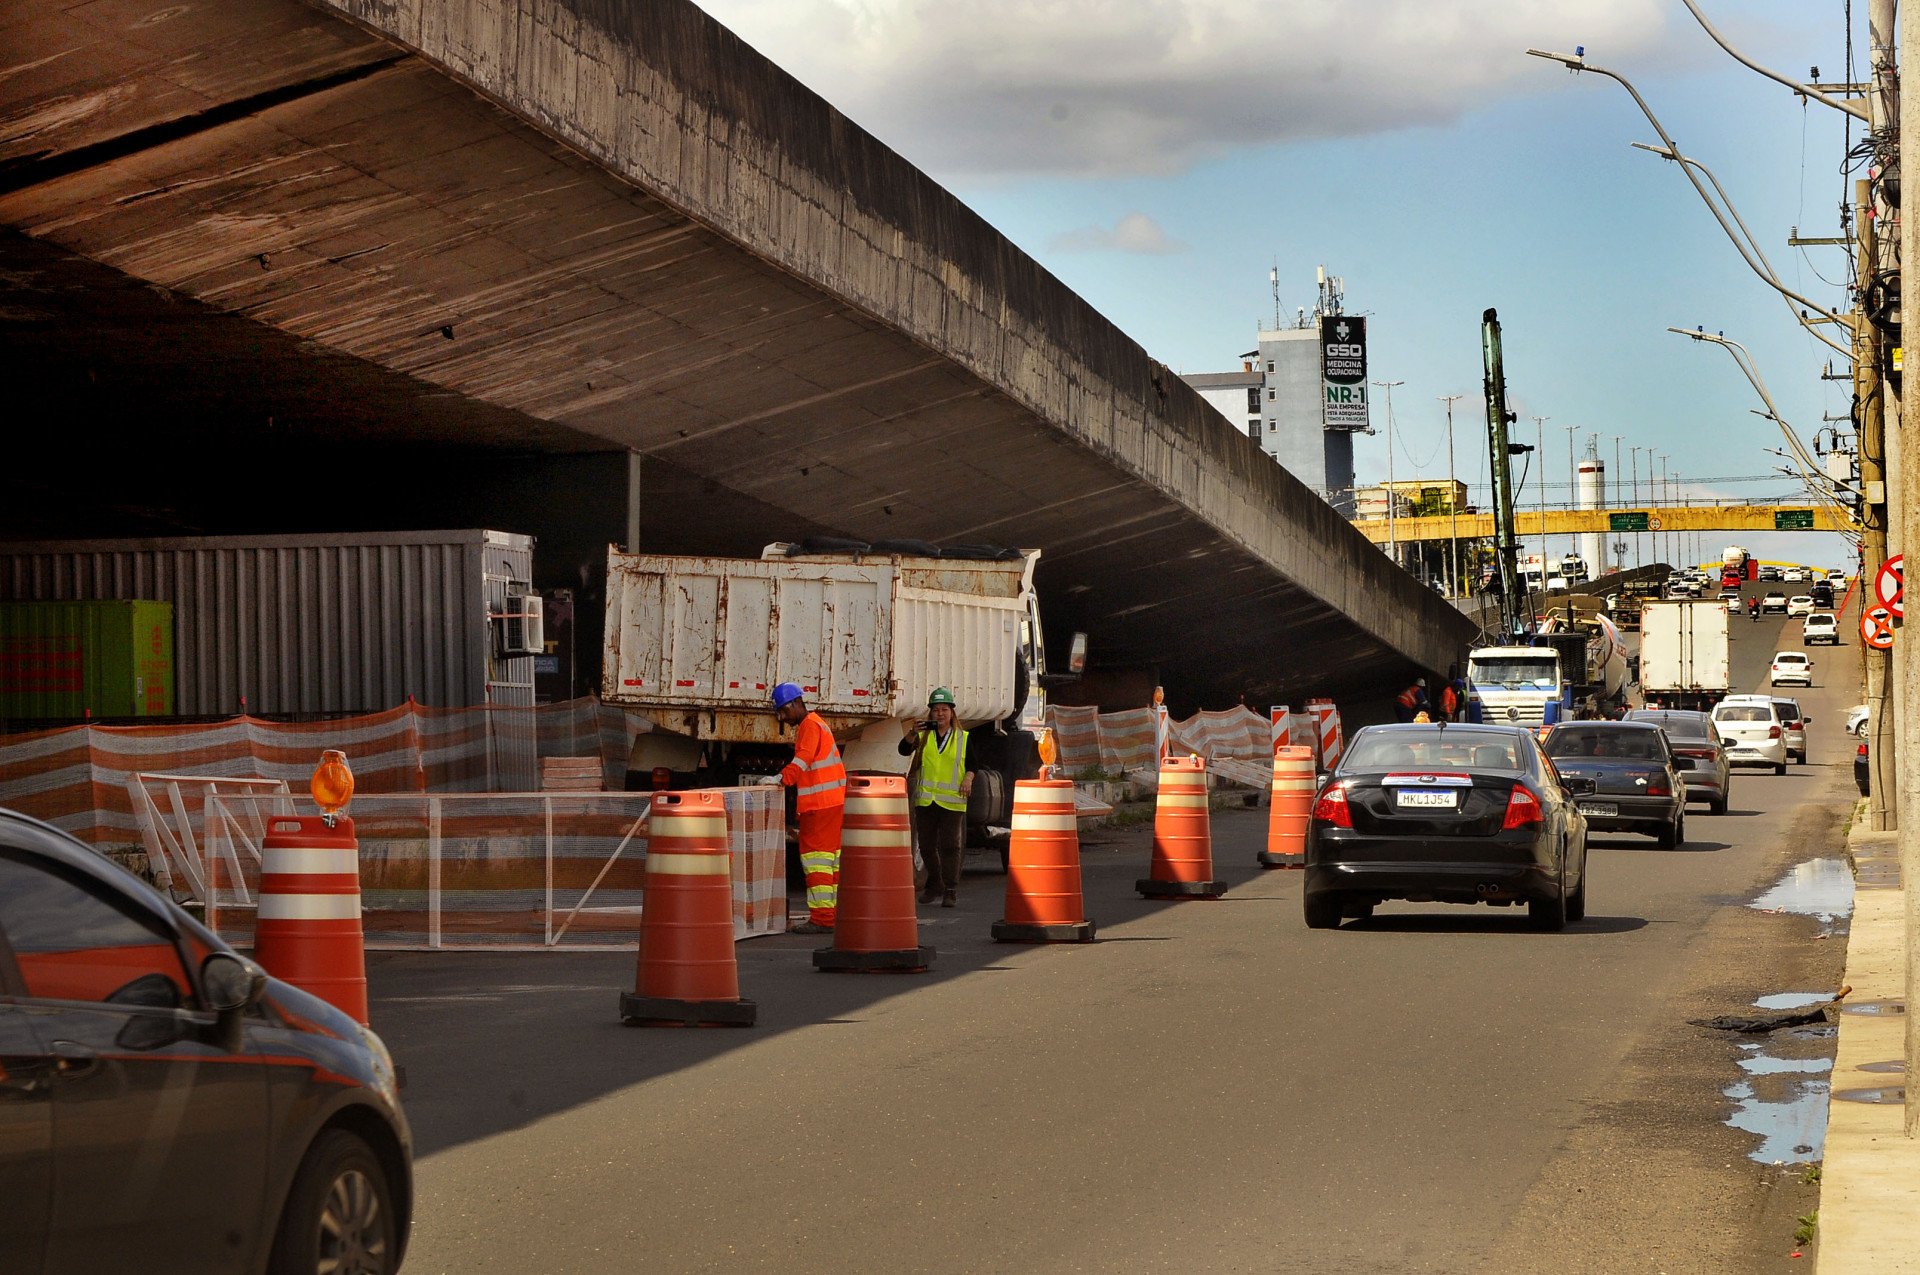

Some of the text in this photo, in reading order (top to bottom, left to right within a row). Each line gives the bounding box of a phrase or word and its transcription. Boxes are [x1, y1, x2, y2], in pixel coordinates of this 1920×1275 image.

[1326, 343, 1362, 357] GSO
[1326, 360, 1362, 368] MEDICINA
[1327, 368, 1362, 376] OCUPACIONAL
[1327, 386, 1365, 403] NR-1
